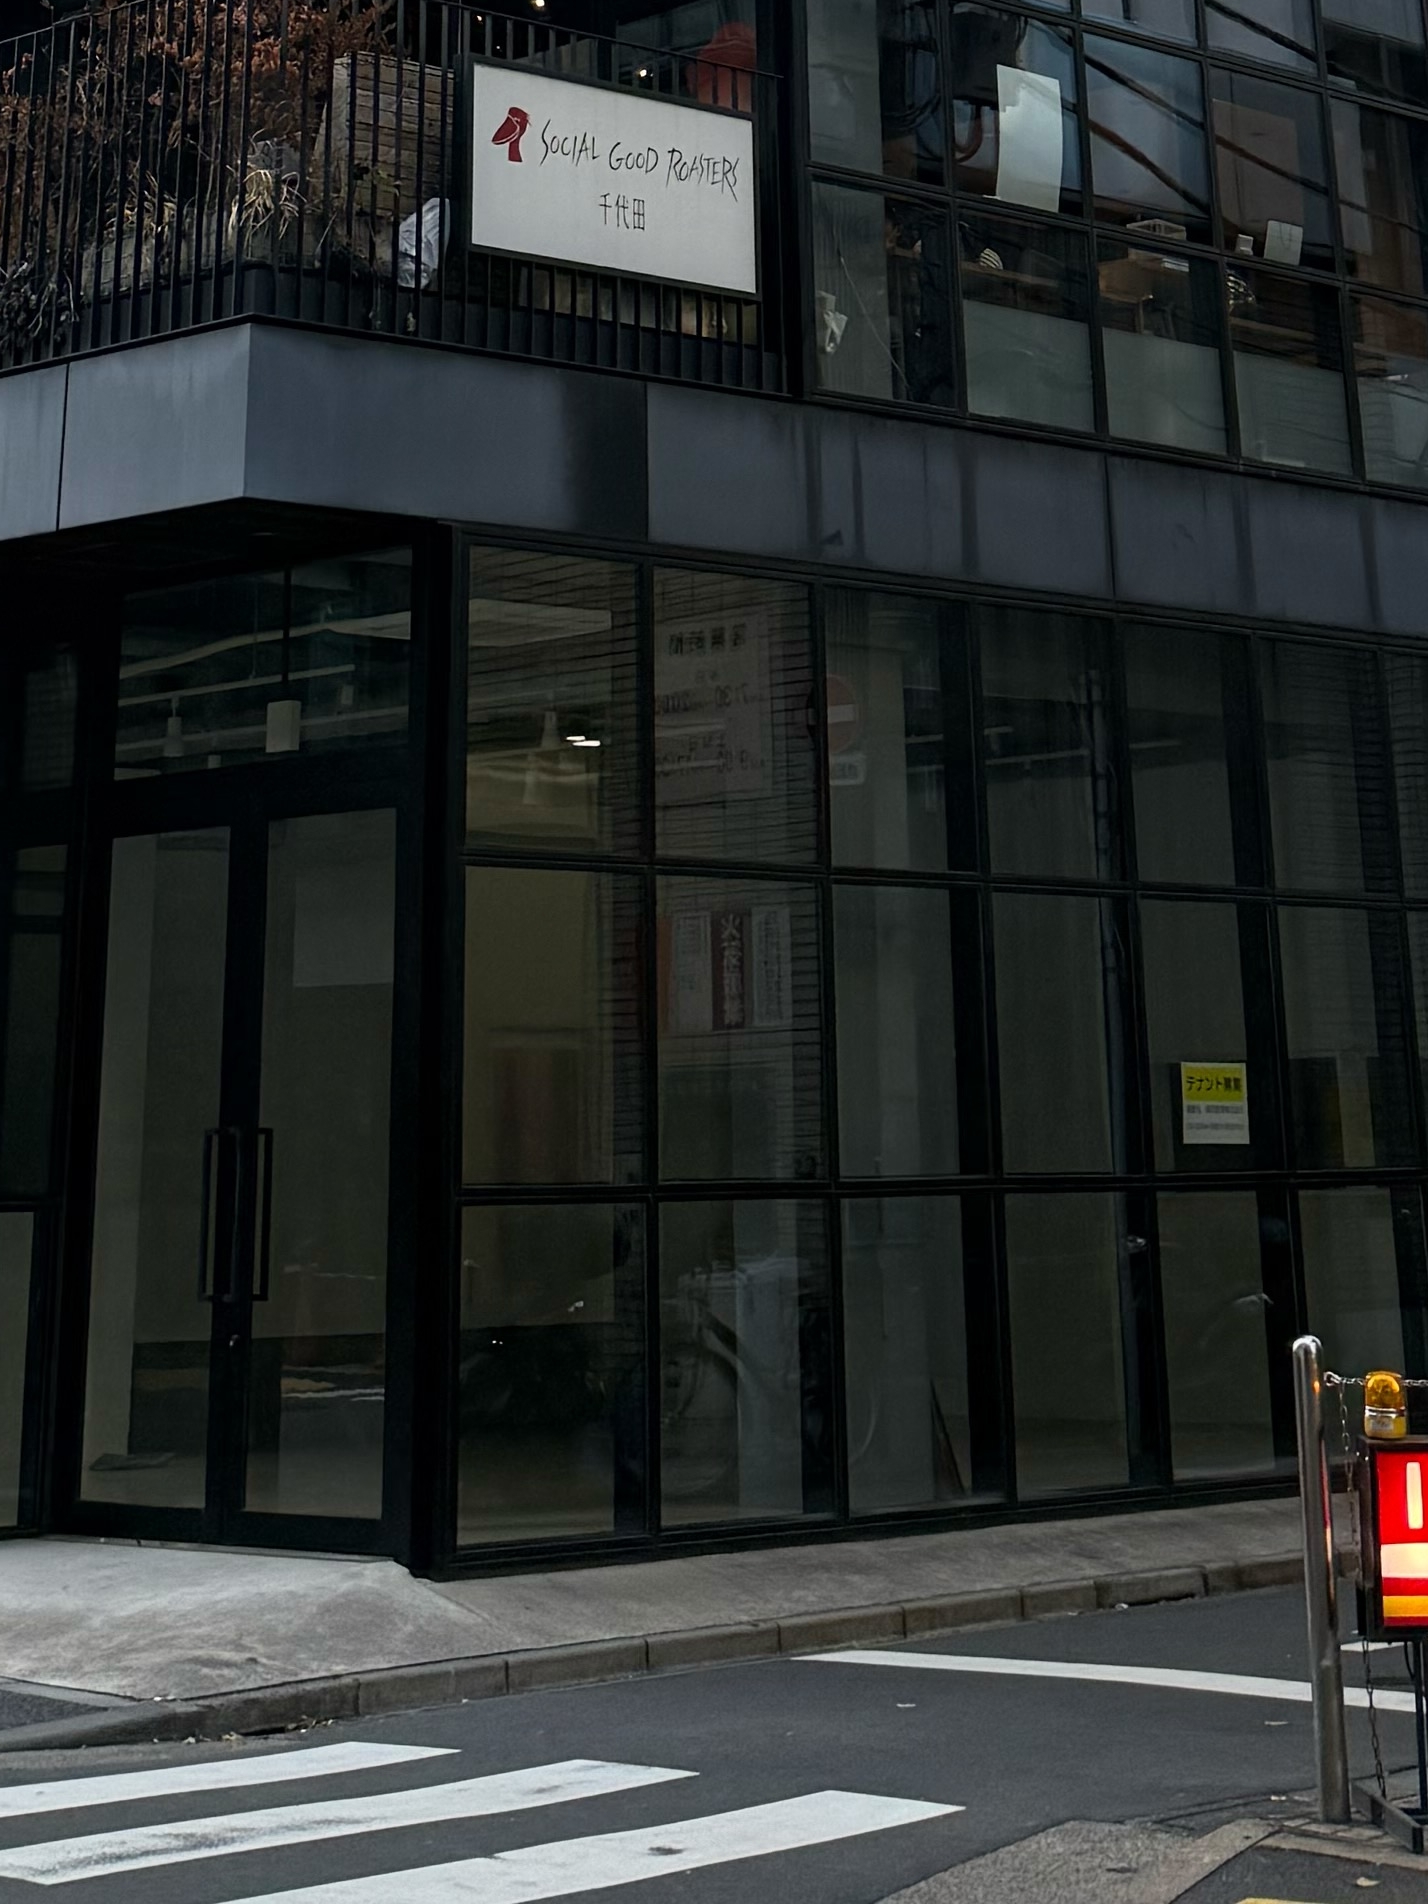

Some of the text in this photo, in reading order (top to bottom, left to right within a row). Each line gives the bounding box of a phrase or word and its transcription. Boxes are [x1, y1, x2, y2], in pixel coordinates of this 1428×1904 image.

[539, 119, 739, 202] SOCIAL GOOD ROASTERS
[598, 192, 647, 231] 千代田
